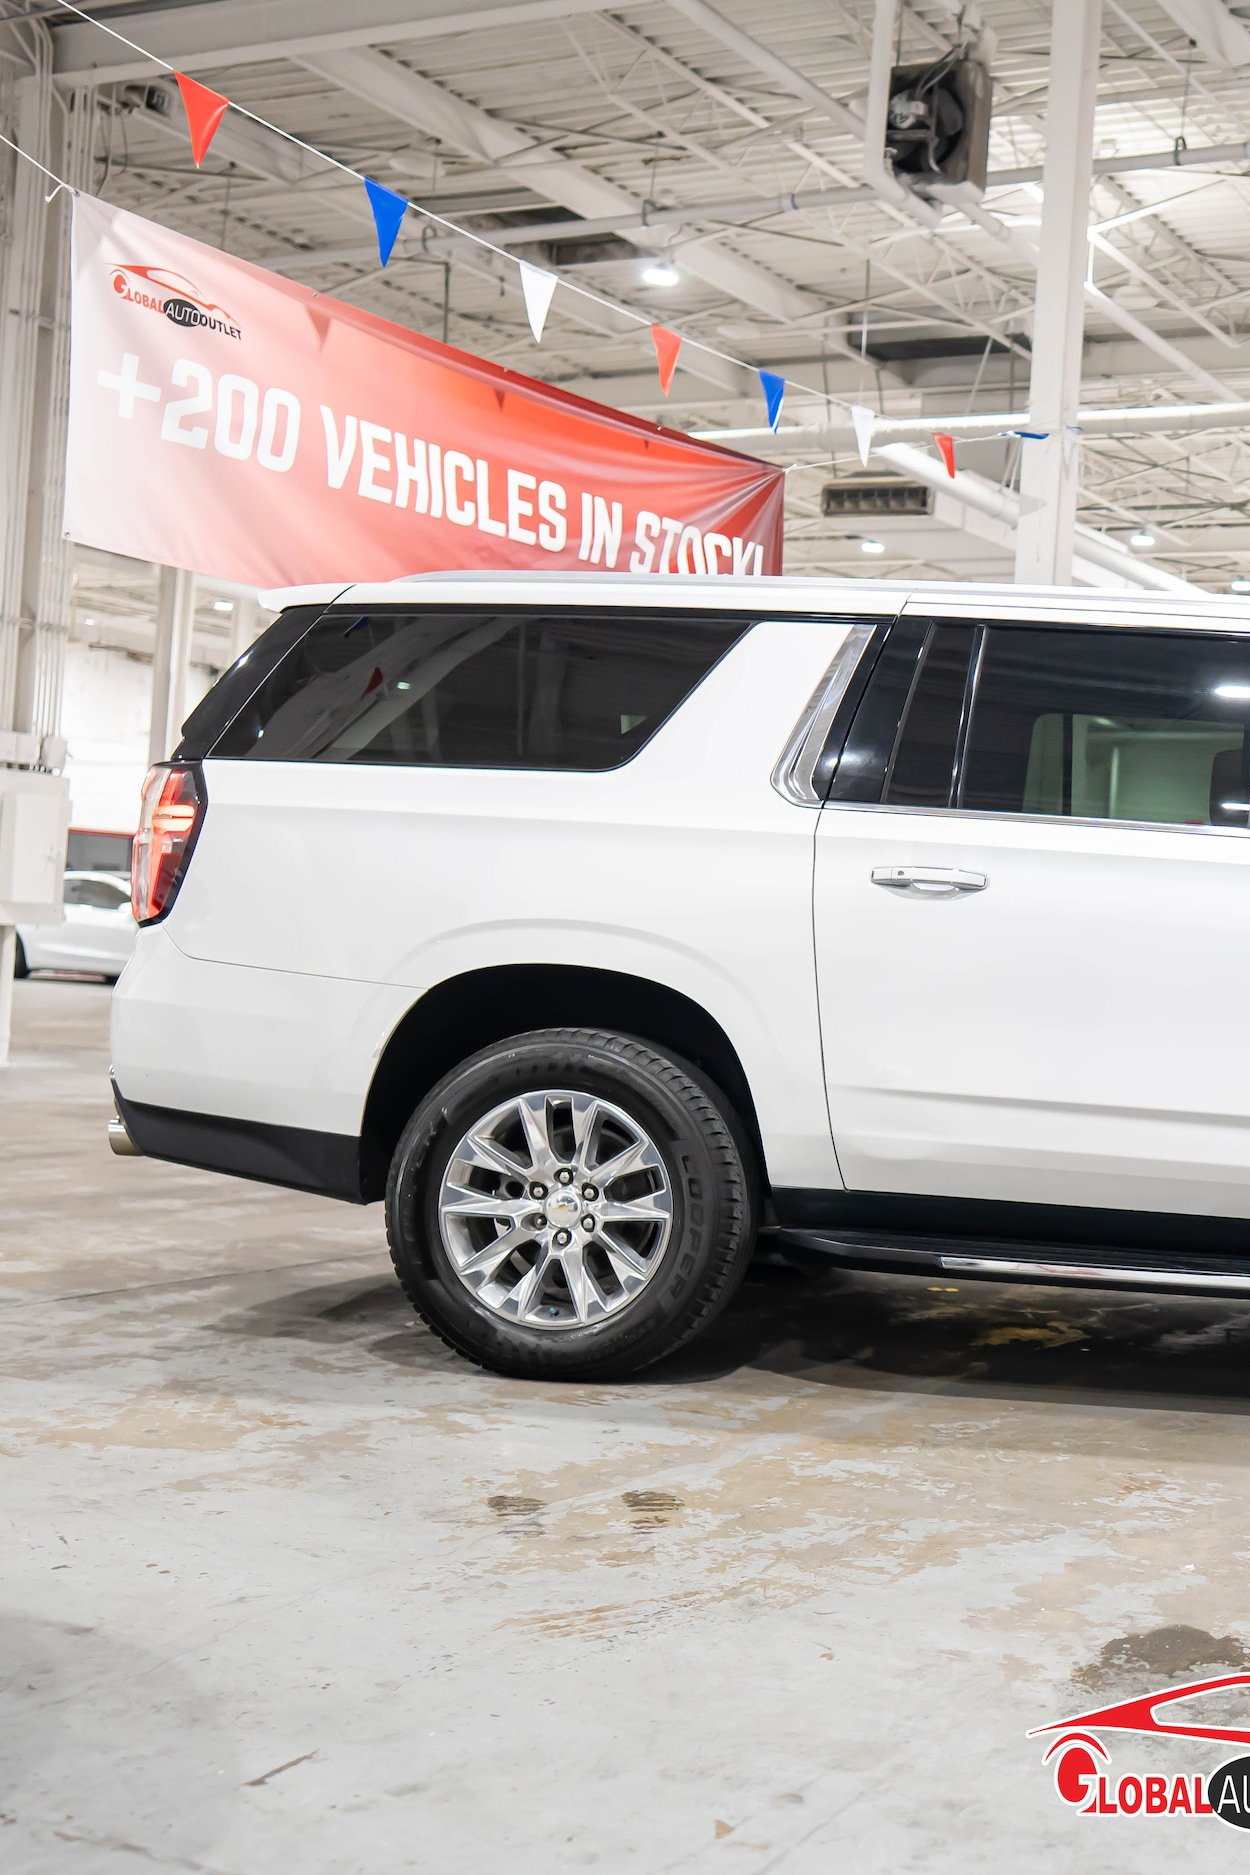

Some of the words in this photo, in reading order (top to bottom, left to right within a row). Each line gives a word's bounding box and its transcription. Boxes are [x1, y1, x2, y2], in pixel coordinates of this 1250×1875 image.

[113, 274, 165, 314] GLOBAL
[165, 302, 201, 326] AUTO
[200, 314, 242, 341] OUTLET
[98, 352, 299, 474] +200
[320, 405, 567, 553] VEHICLES
[578, 491, 623, 570] IN
